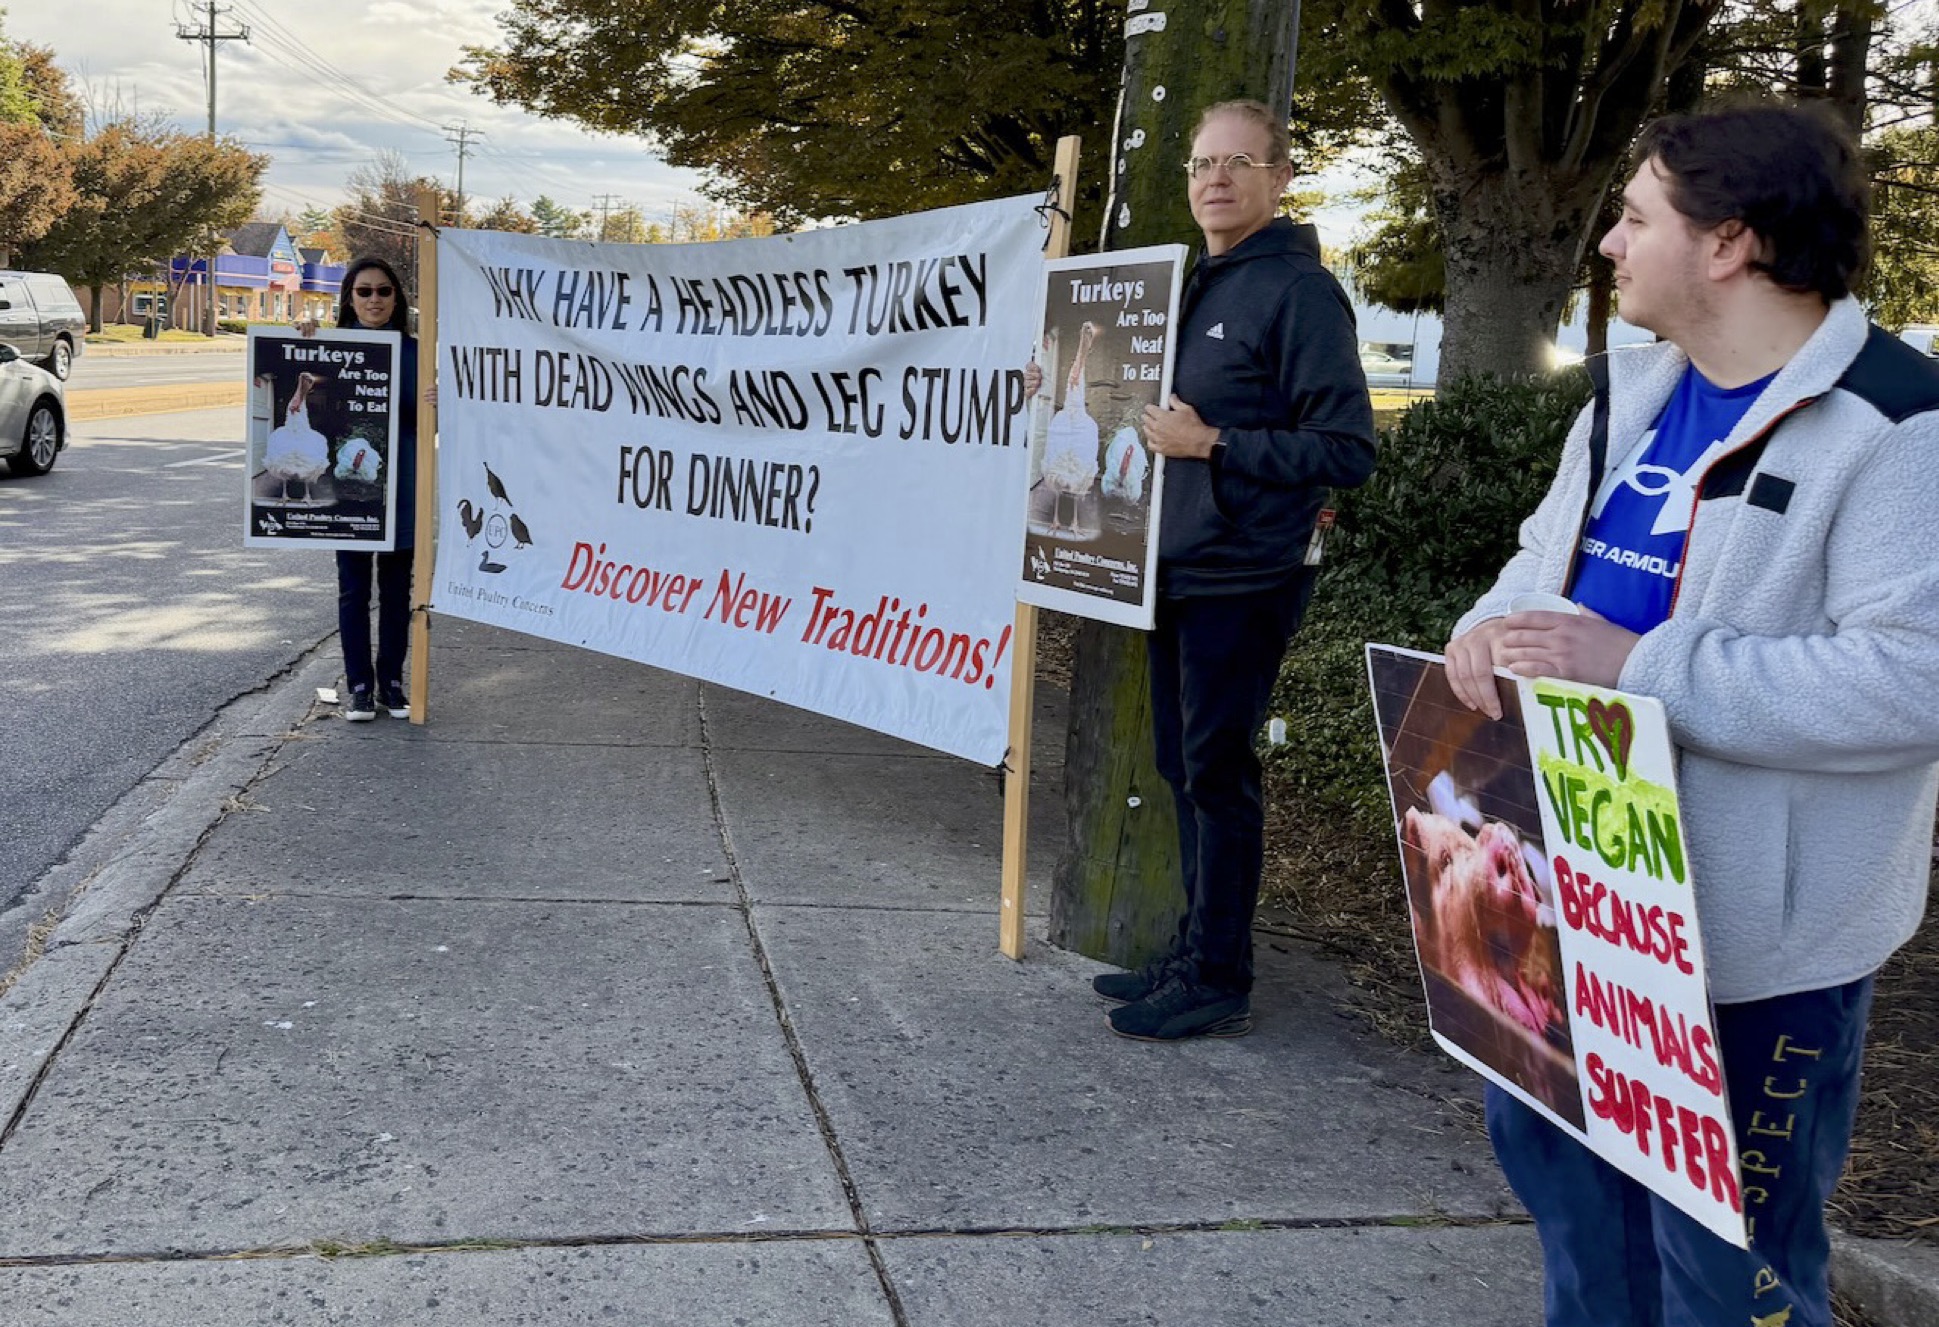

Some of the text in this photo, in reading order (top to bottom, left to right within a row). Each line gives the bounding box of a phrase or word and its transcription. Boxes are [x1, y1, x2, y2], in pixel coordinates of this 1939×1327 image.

[480, 253, 988, 337] WHY HAVE A HEADLESS TURKEY
[1070, 276, 1145, 308] Turkeys
[1116, 308, 1165, 327] Are Too
[282, 344, 365, 368] Turkeys
[338, 368, 388, 381] Are Too
[1122, 364, 1161, 381] To Eat
[1130, 335, 1163, 354] Neat
[347, 400, 388, 413] To Eat
[355, 384, 388, 397] Neat
[451, 345, 1027, 448] WITH DEAD WINGS AND LEG STUMP
[617, 446, 821, 534] FOR DINNER?
[1582, 536, 1680, 578] ER ARMOU
[561, 541, 1012, 690] Discover New Traditions!
[1536, 693, 1628, 781] TRY
[1543, 770, 1686, 885] VEGAN
[1554, 855, 1694, 975] BECAUSE
[1575, 961, 1721, 1096] ANIMALS
[1586, 1052, 1742, 1213] SUFFER
